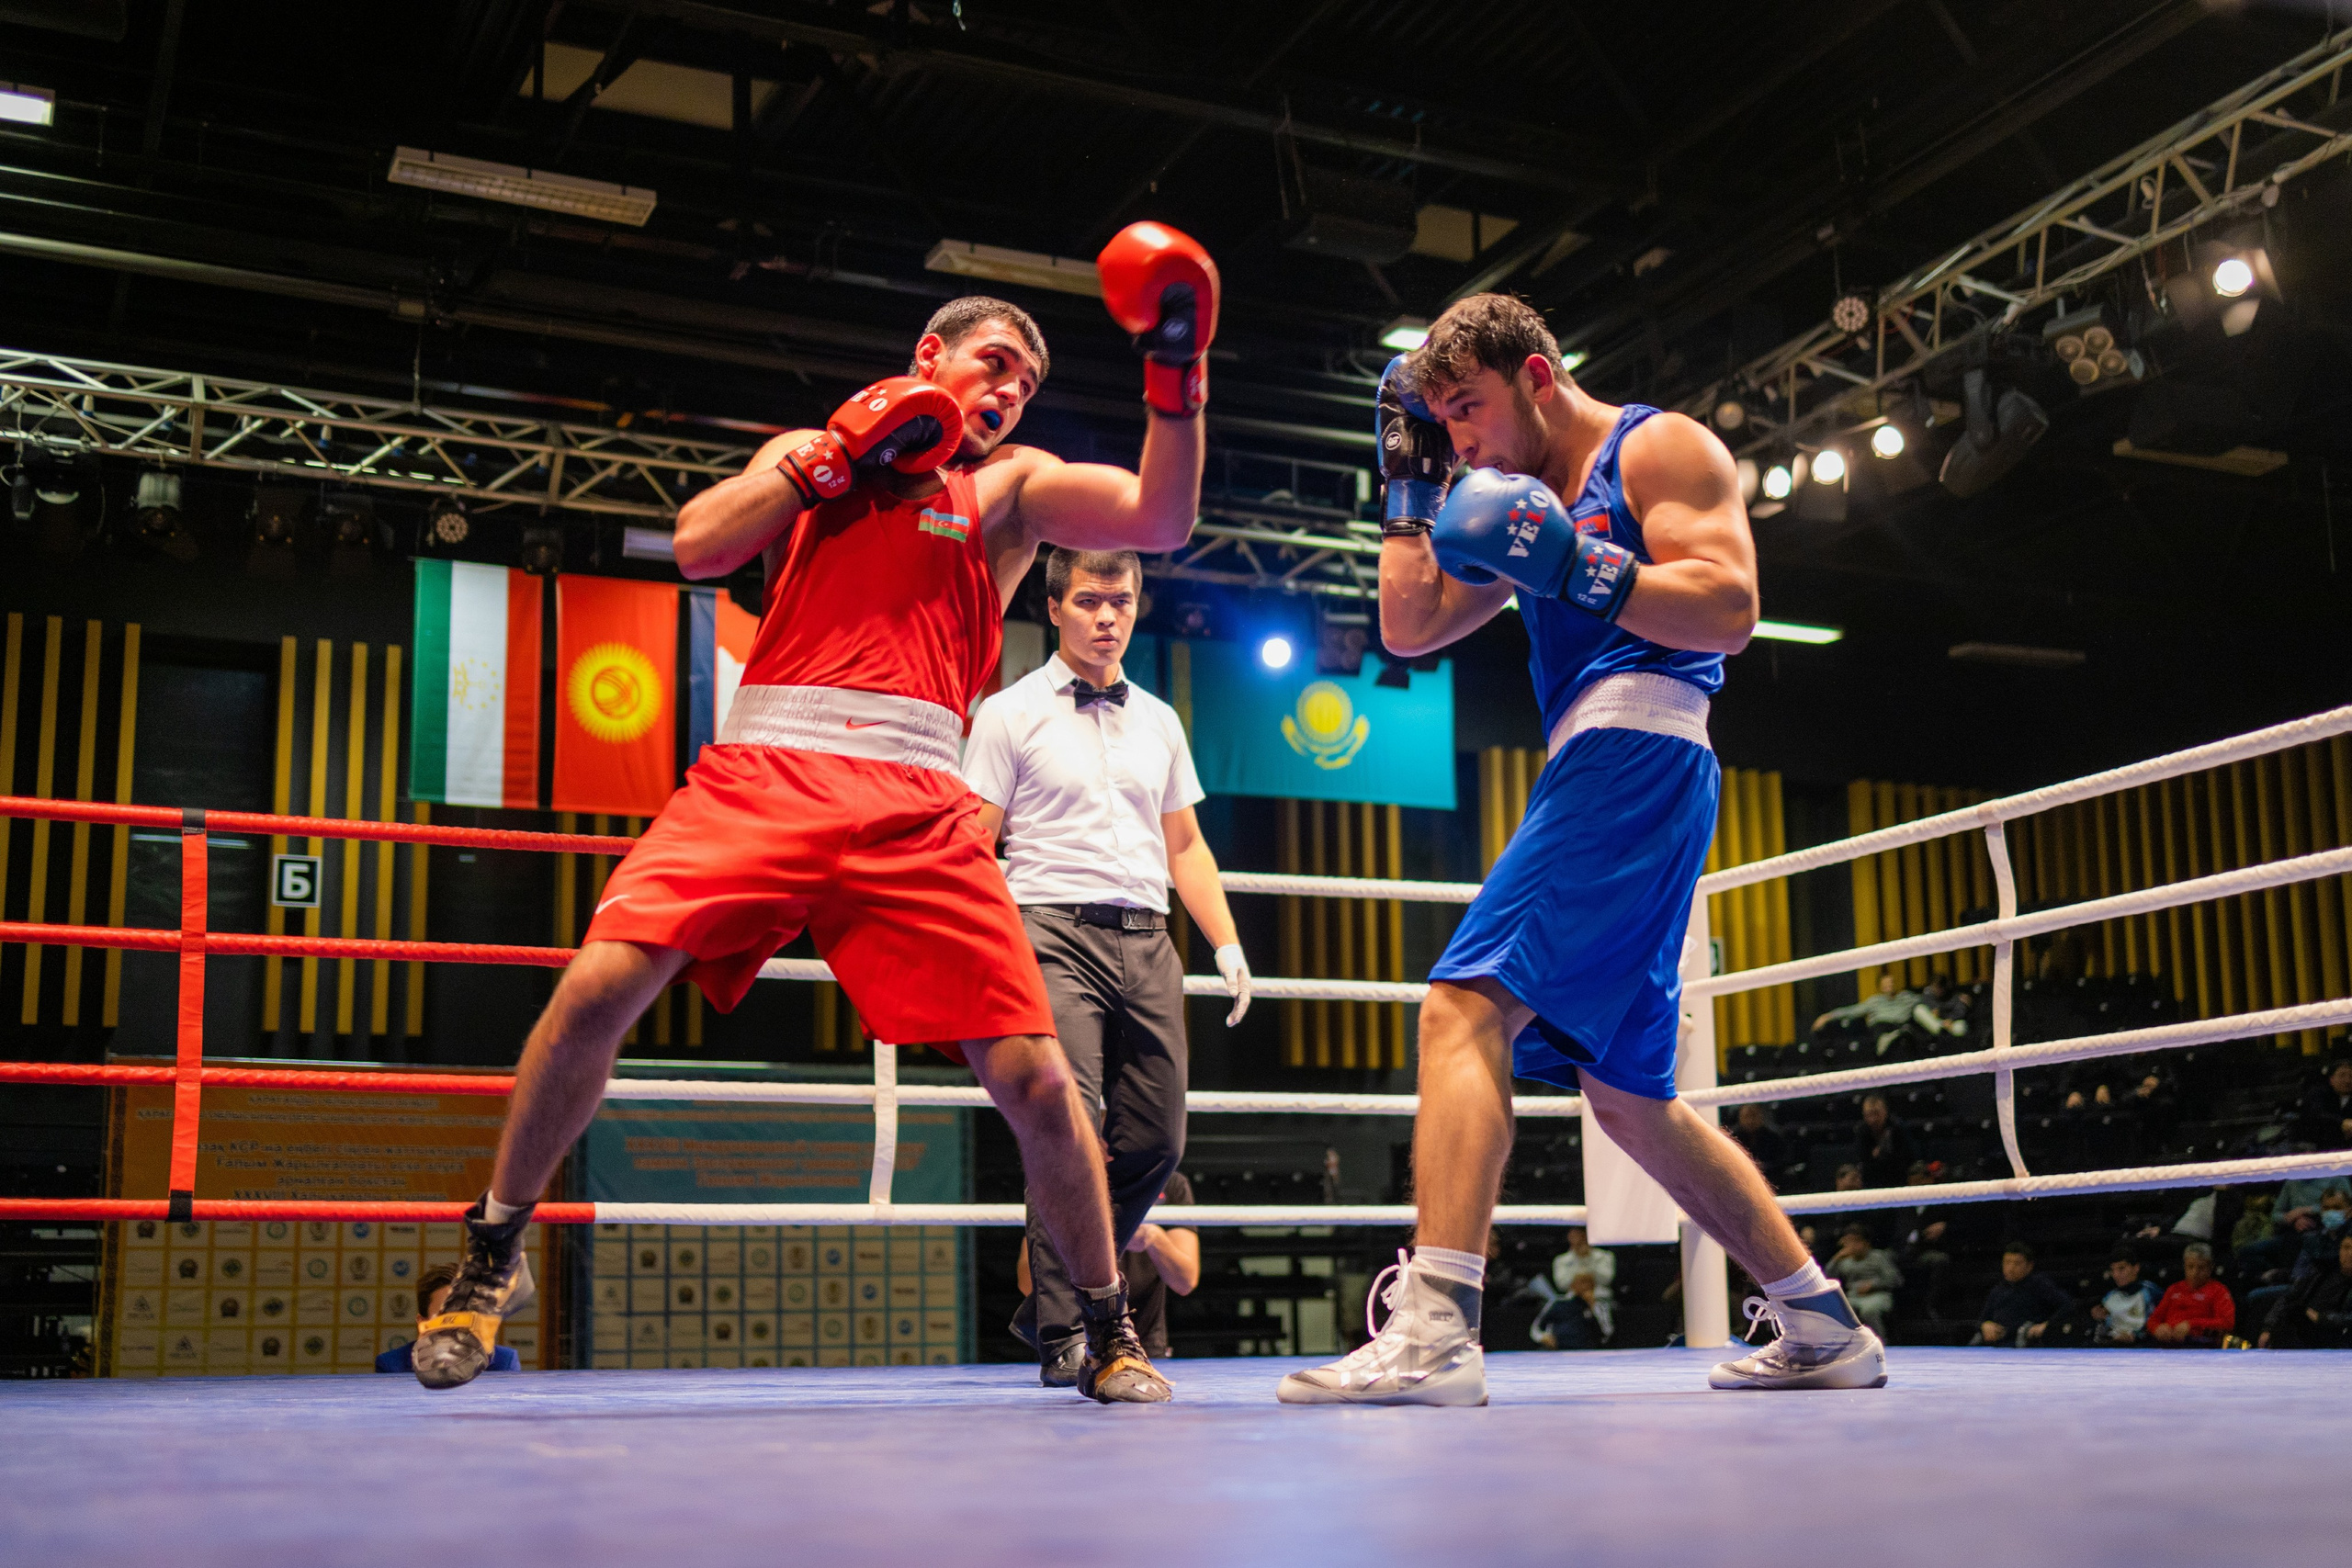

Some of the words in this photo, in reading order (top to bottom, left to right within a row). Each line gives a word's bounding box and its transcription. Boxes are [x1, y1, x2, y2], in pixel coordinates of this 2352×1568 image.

[850, 389, 888, 412] ELO
[796, 442, 833, 483] ELO
[1507, 491, 1550, 558] VELO
[1589, 542, 1624, 594] VELO
[282, 863, 311, 899] Б
